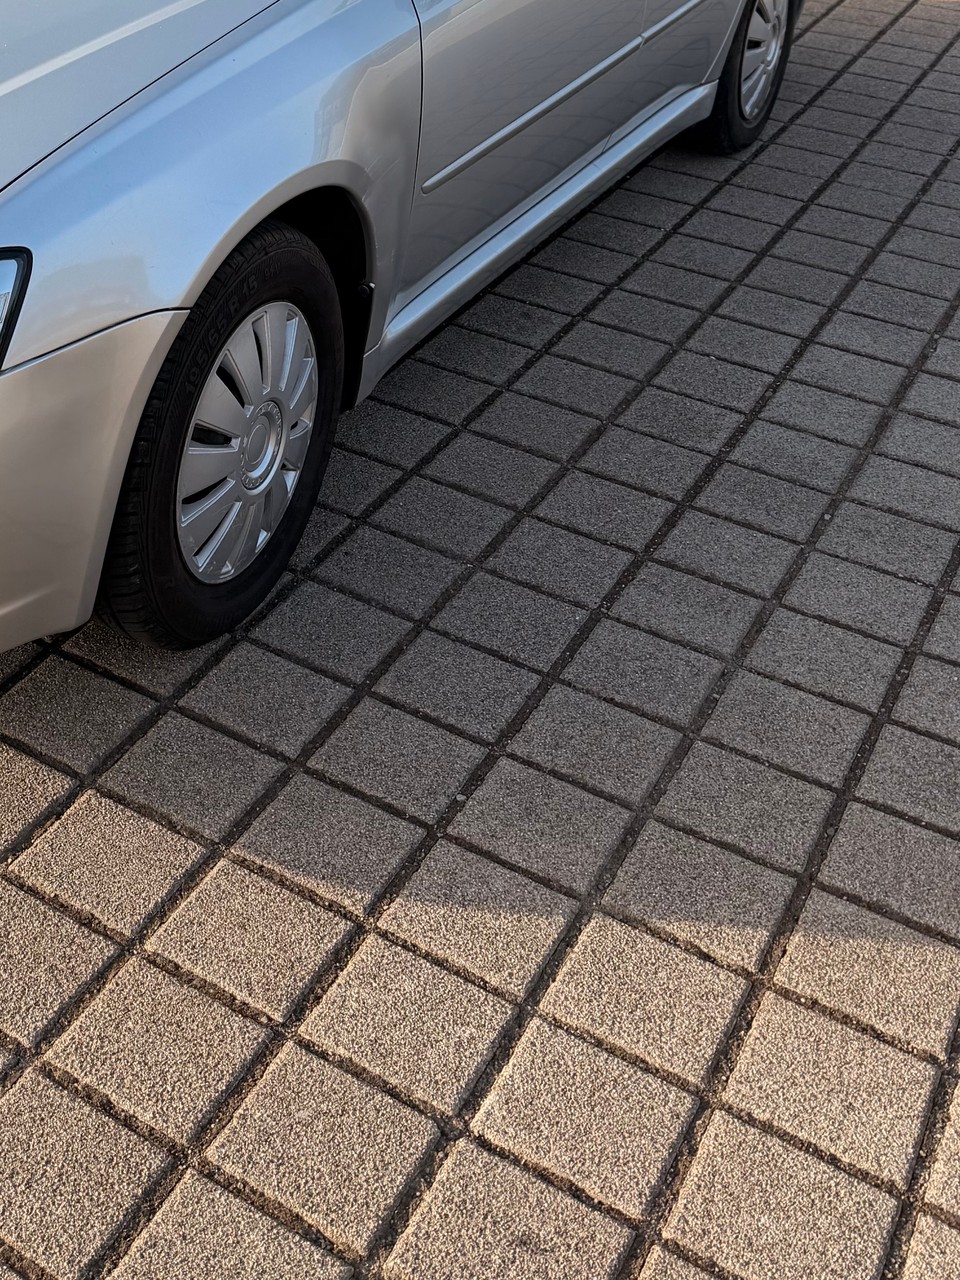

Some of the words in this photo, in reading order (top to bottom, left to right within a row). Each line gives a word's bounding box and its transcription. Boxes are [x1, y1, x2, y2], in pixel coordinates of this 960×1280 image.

[185, 308, 229, 394] 195/65
[229, 296, 242, 318] R
[242, 275, 259, 297] 15
